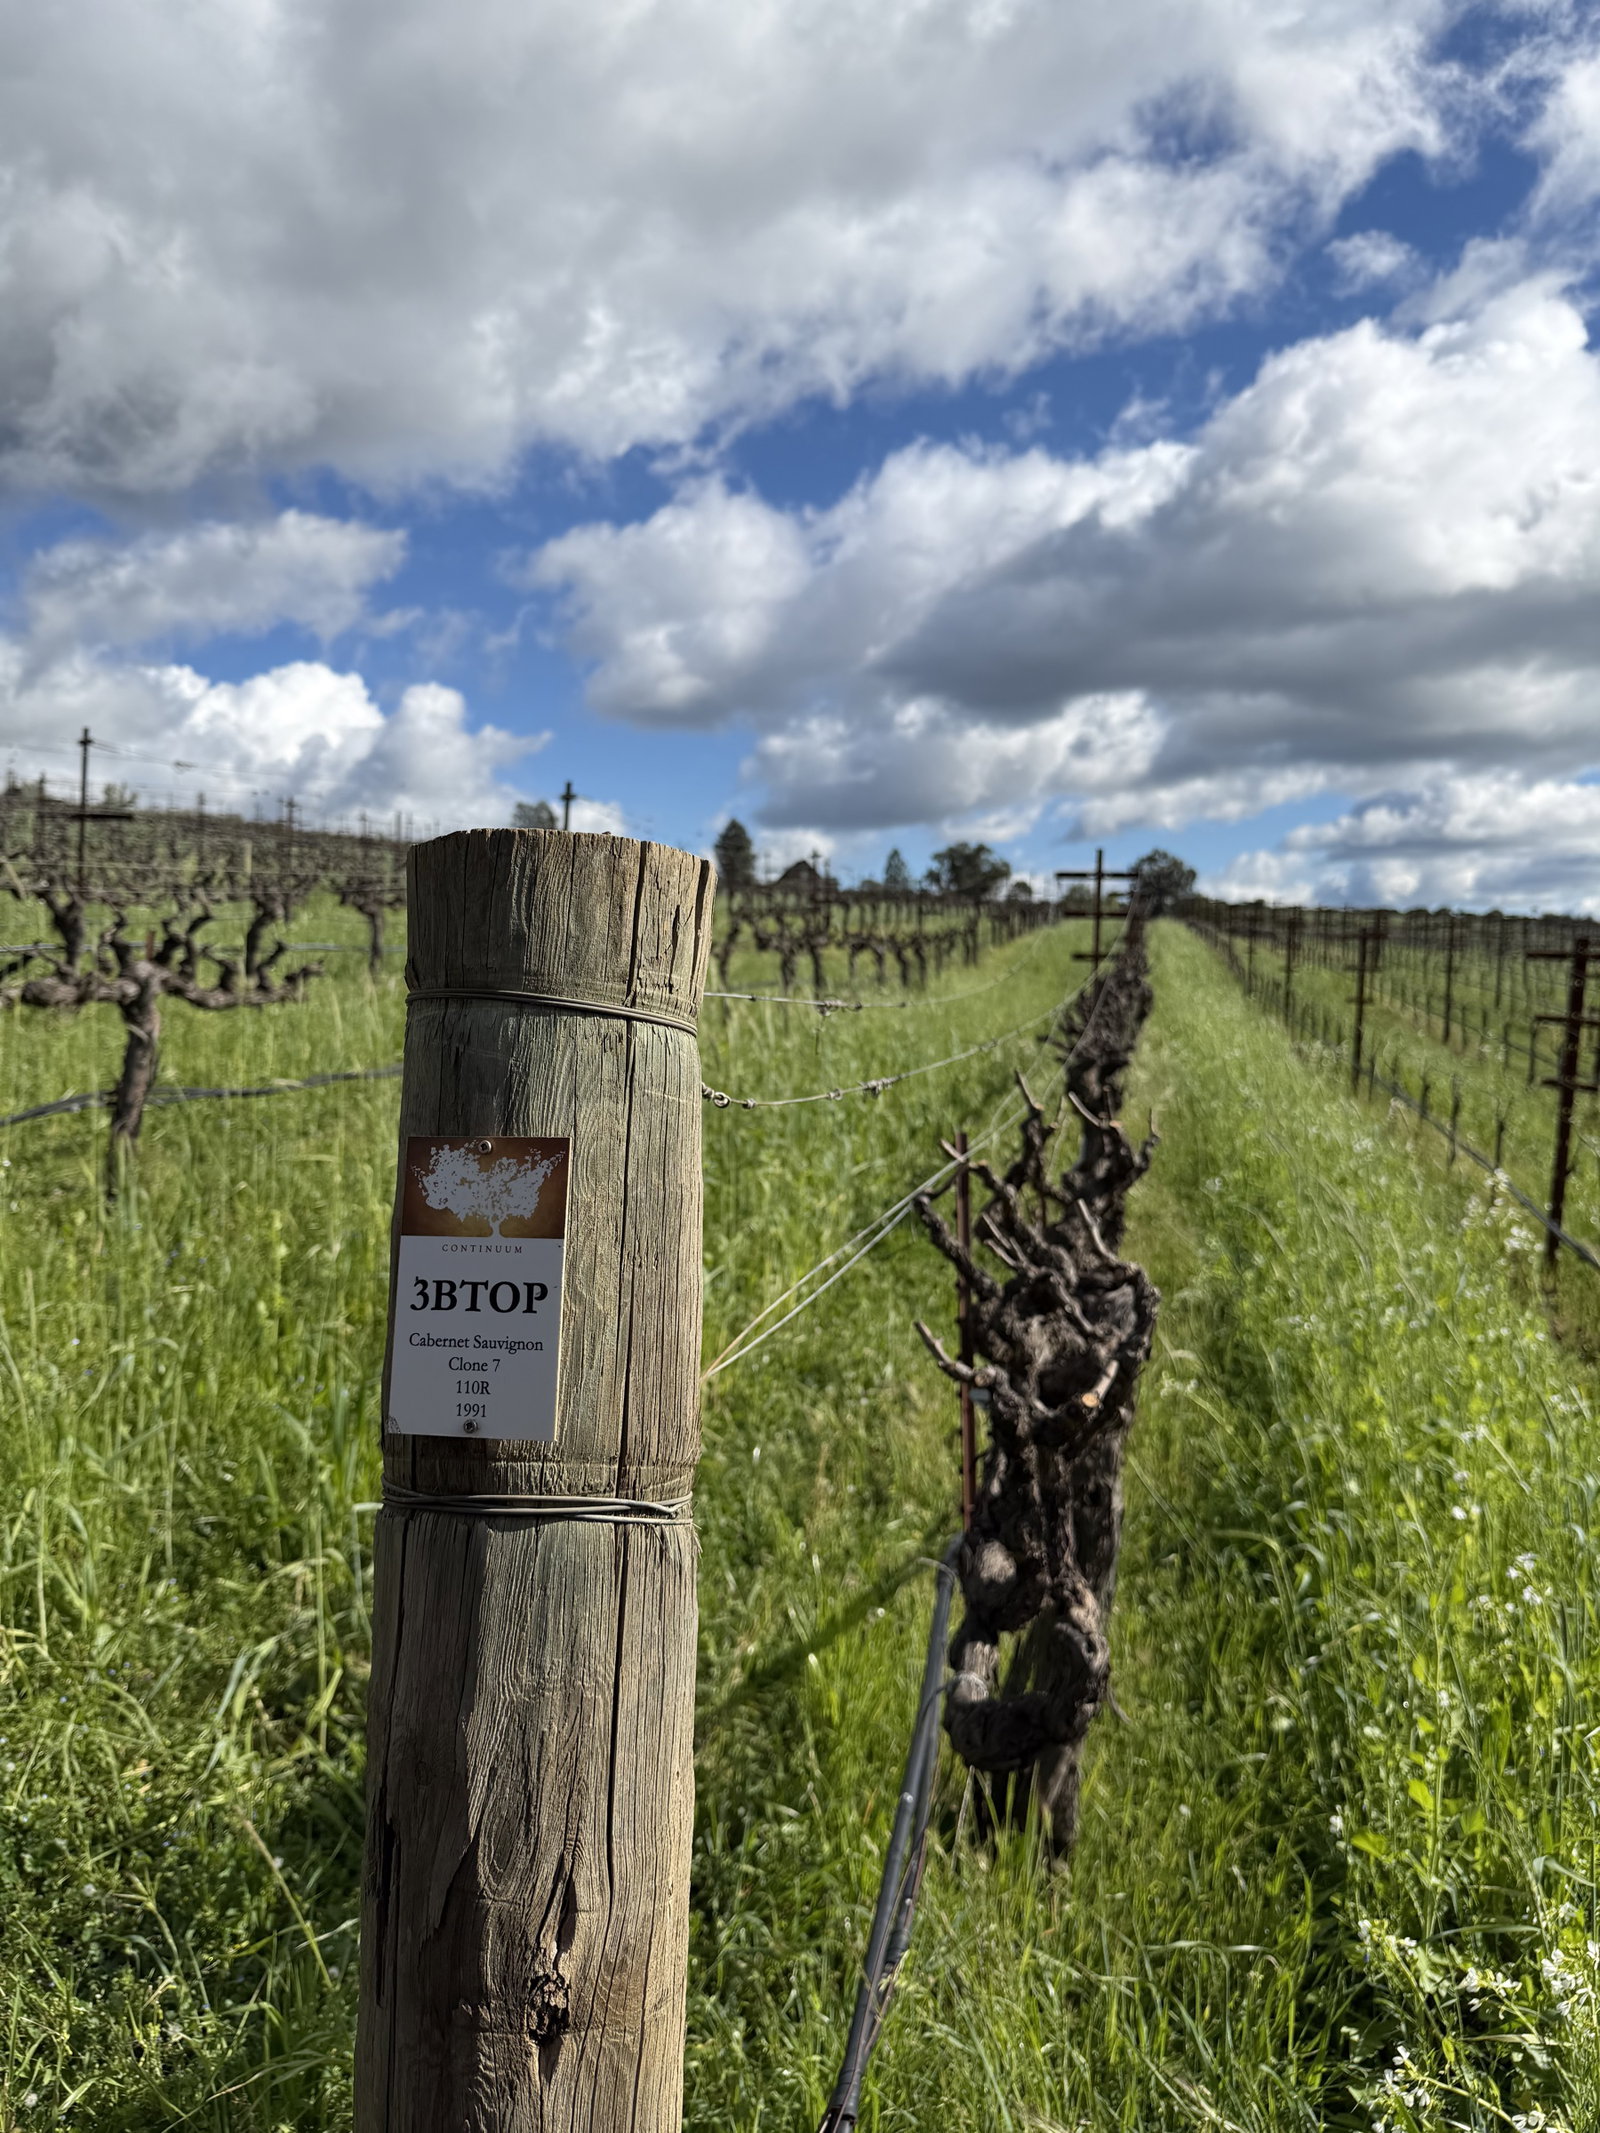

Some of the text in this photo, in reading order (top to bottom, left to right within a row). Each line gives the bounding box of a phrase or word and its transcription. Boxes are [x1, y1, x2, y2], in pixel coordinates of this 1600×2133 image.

[441, 1243, 523, 1254] CONTINUUM
[410, 1277, 549, 1314] 3BTOP
[409, 1333, 544, 1355] Cabernet Sauvignon
[448, 1357, 501, 1372] Clone 7
[456, 1380, 491, 1395] 110R
[456, 1403, 487, 1418] 1991
